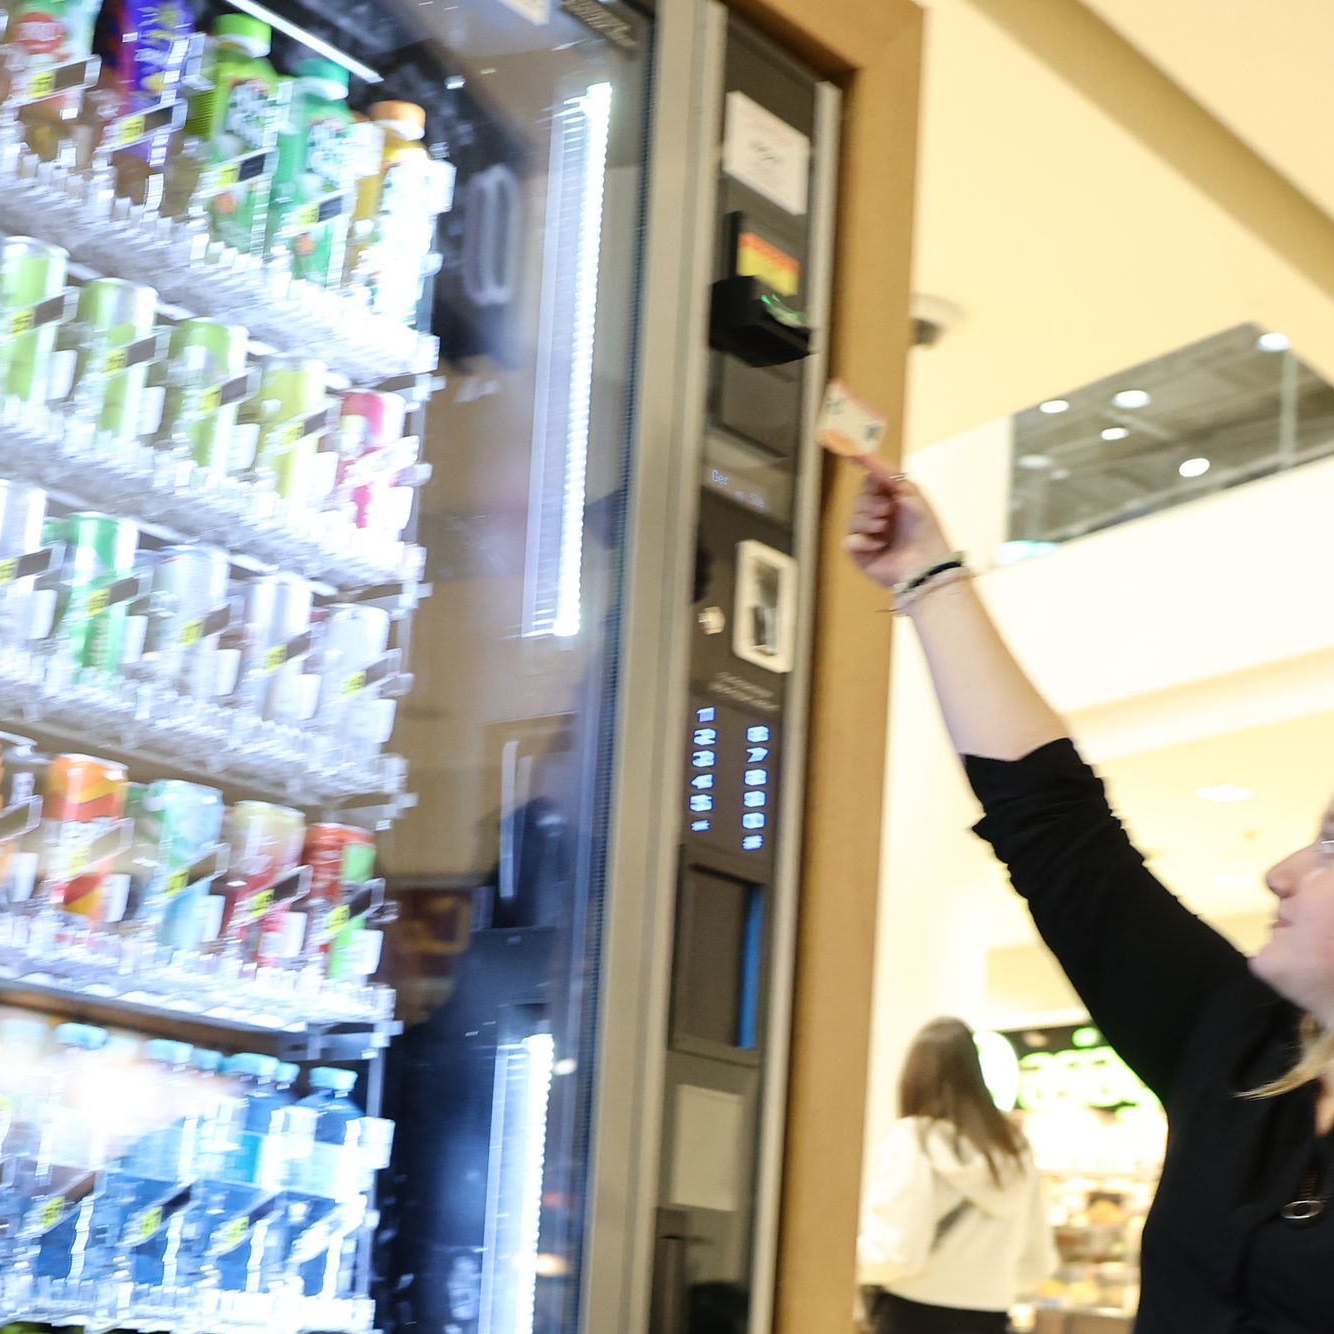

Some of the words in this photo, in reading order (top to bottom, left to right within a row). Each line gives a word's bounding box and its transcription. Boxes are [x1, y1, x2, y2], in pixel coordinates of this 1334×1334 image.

[696, 706, 715, 723] 1
[693, 728, 716, 746] 2
[692, 750, 715, 768] 3
[746, 747, 768, 763] 7
[691, 774, 713, 790] 4
[689, 794, 713, 812] 5
